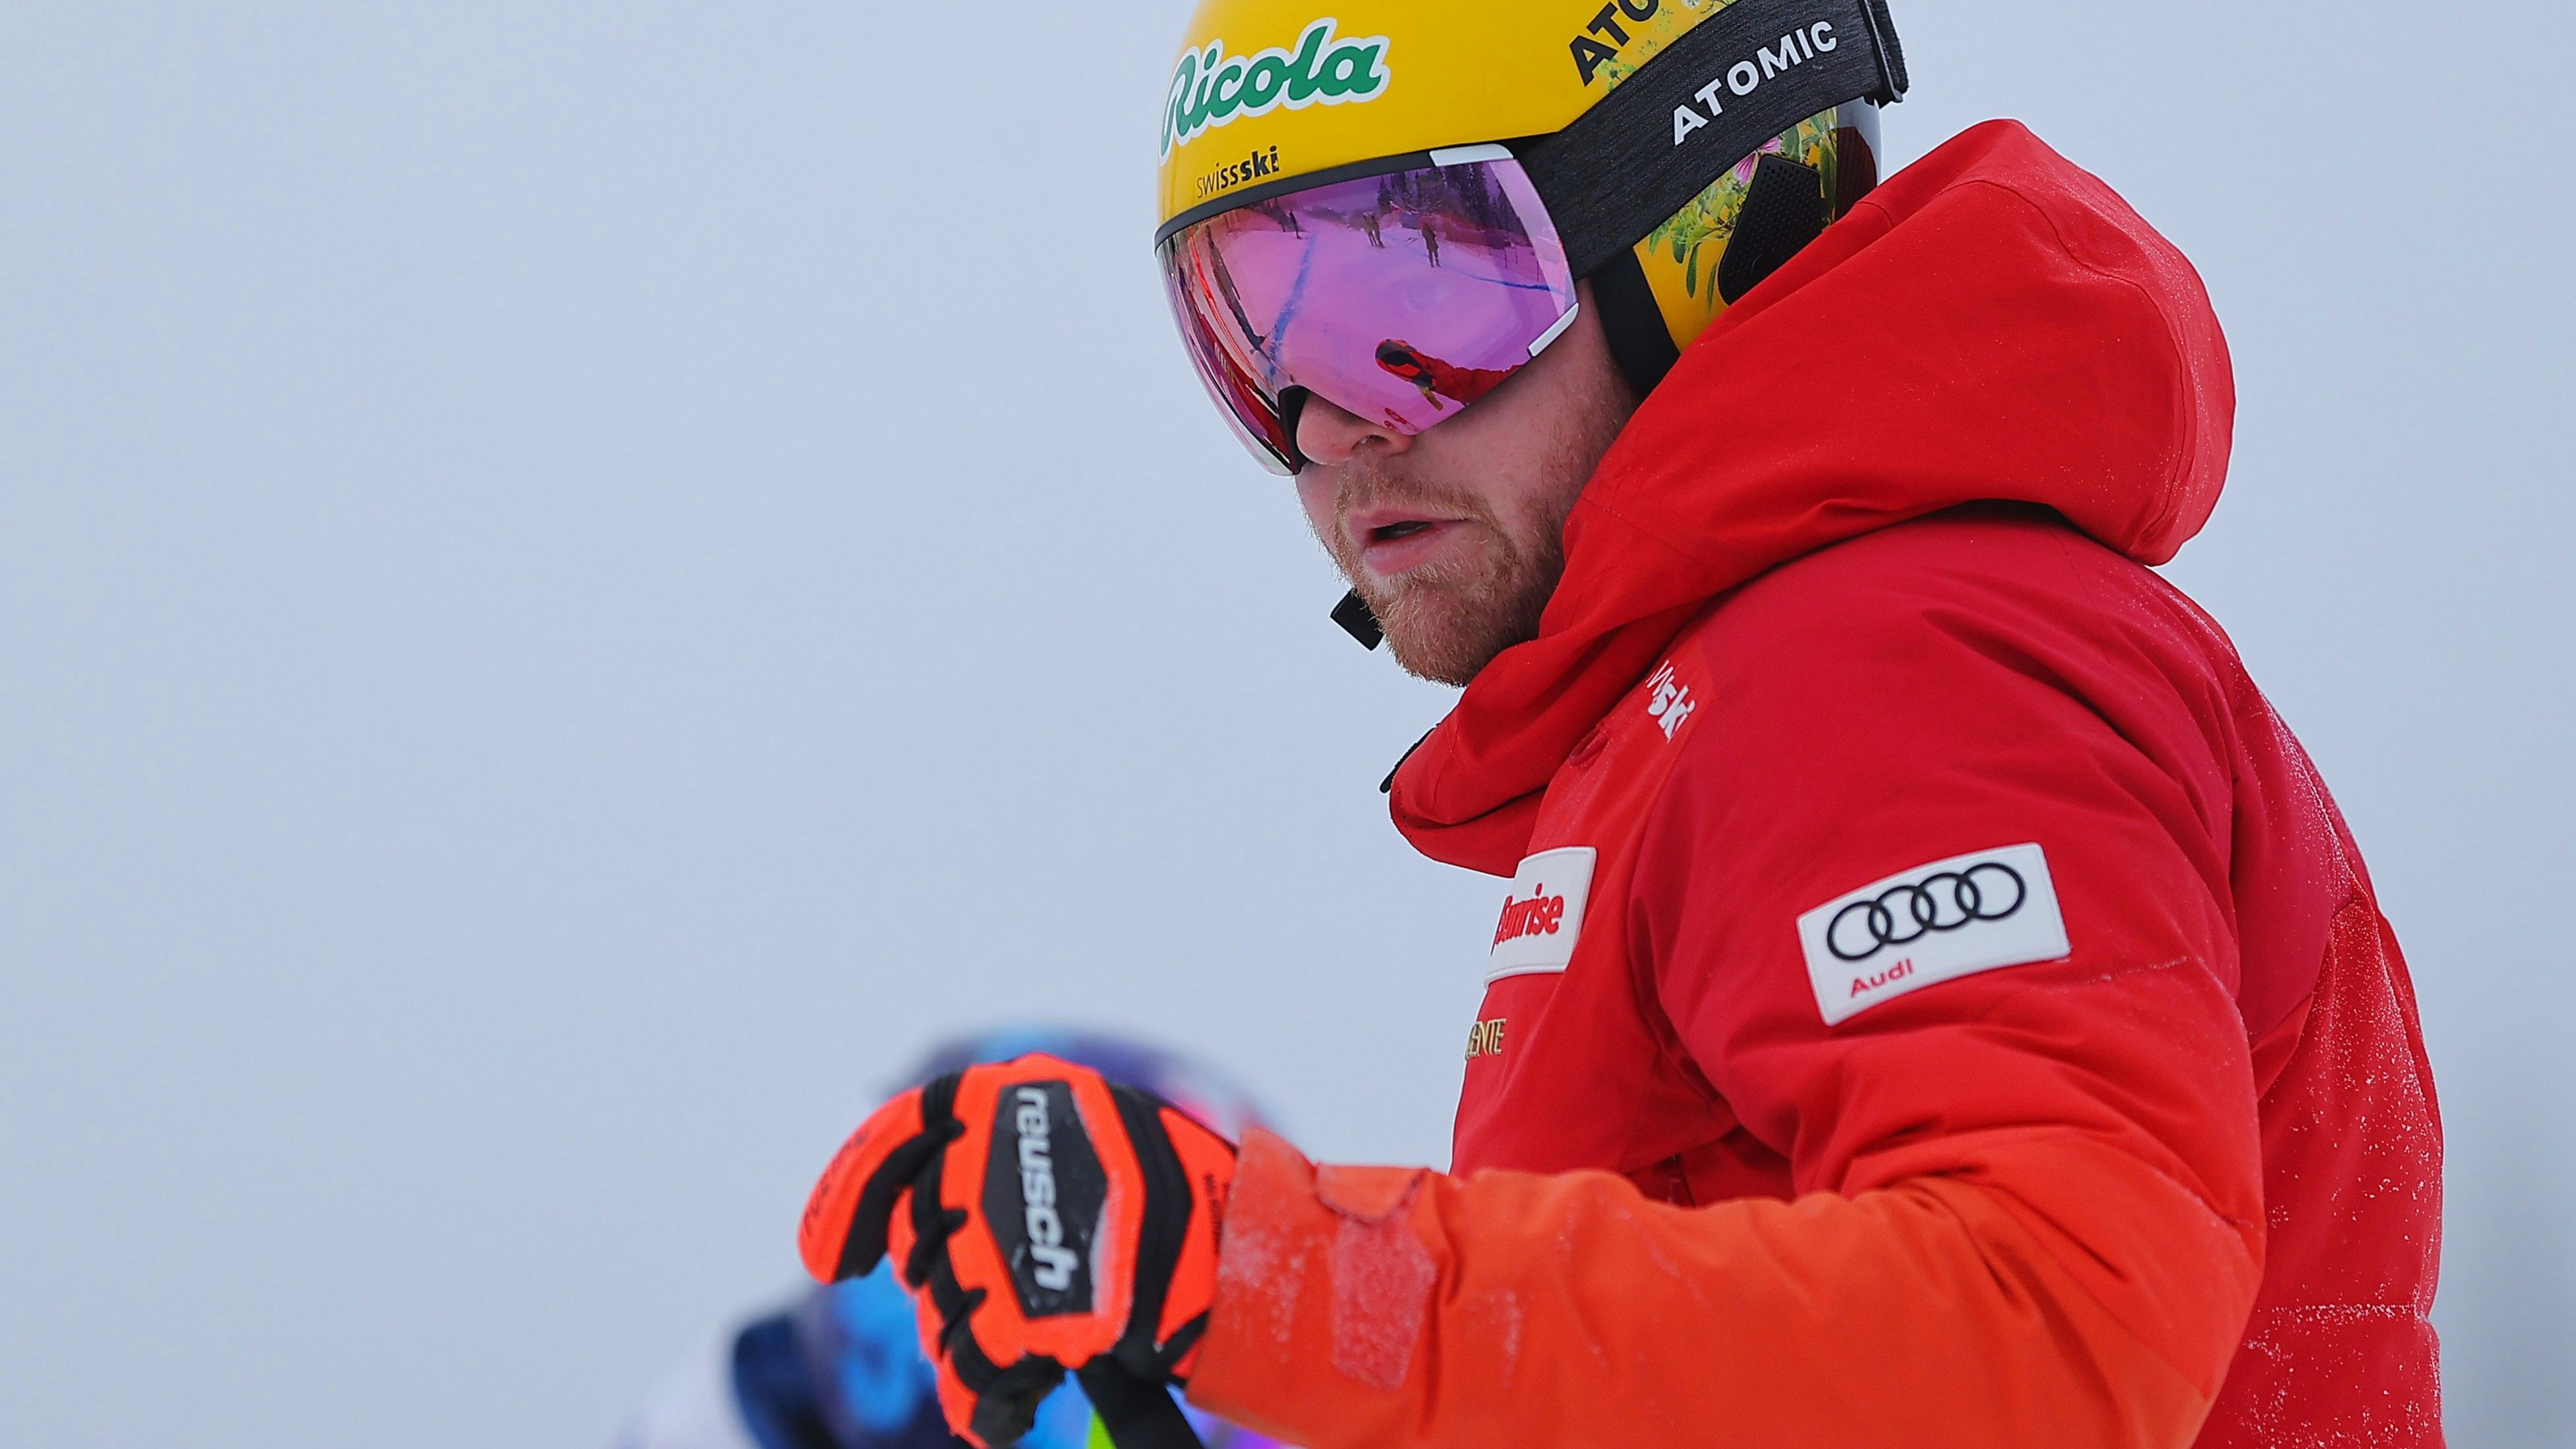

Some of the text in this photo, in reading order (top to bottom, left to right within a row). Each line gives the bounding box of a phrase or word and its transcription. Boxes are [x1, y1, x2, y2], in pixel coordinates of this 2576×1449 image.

[1160, 24, 1382, 157] Ricola
[1673, 20, 1837, 146] ATOMIC
[1196, 146, 1279, 198] swissski
[1851, 959, 1913, 999] Audi
[1016, 1086, 1078, 1291] reusch
